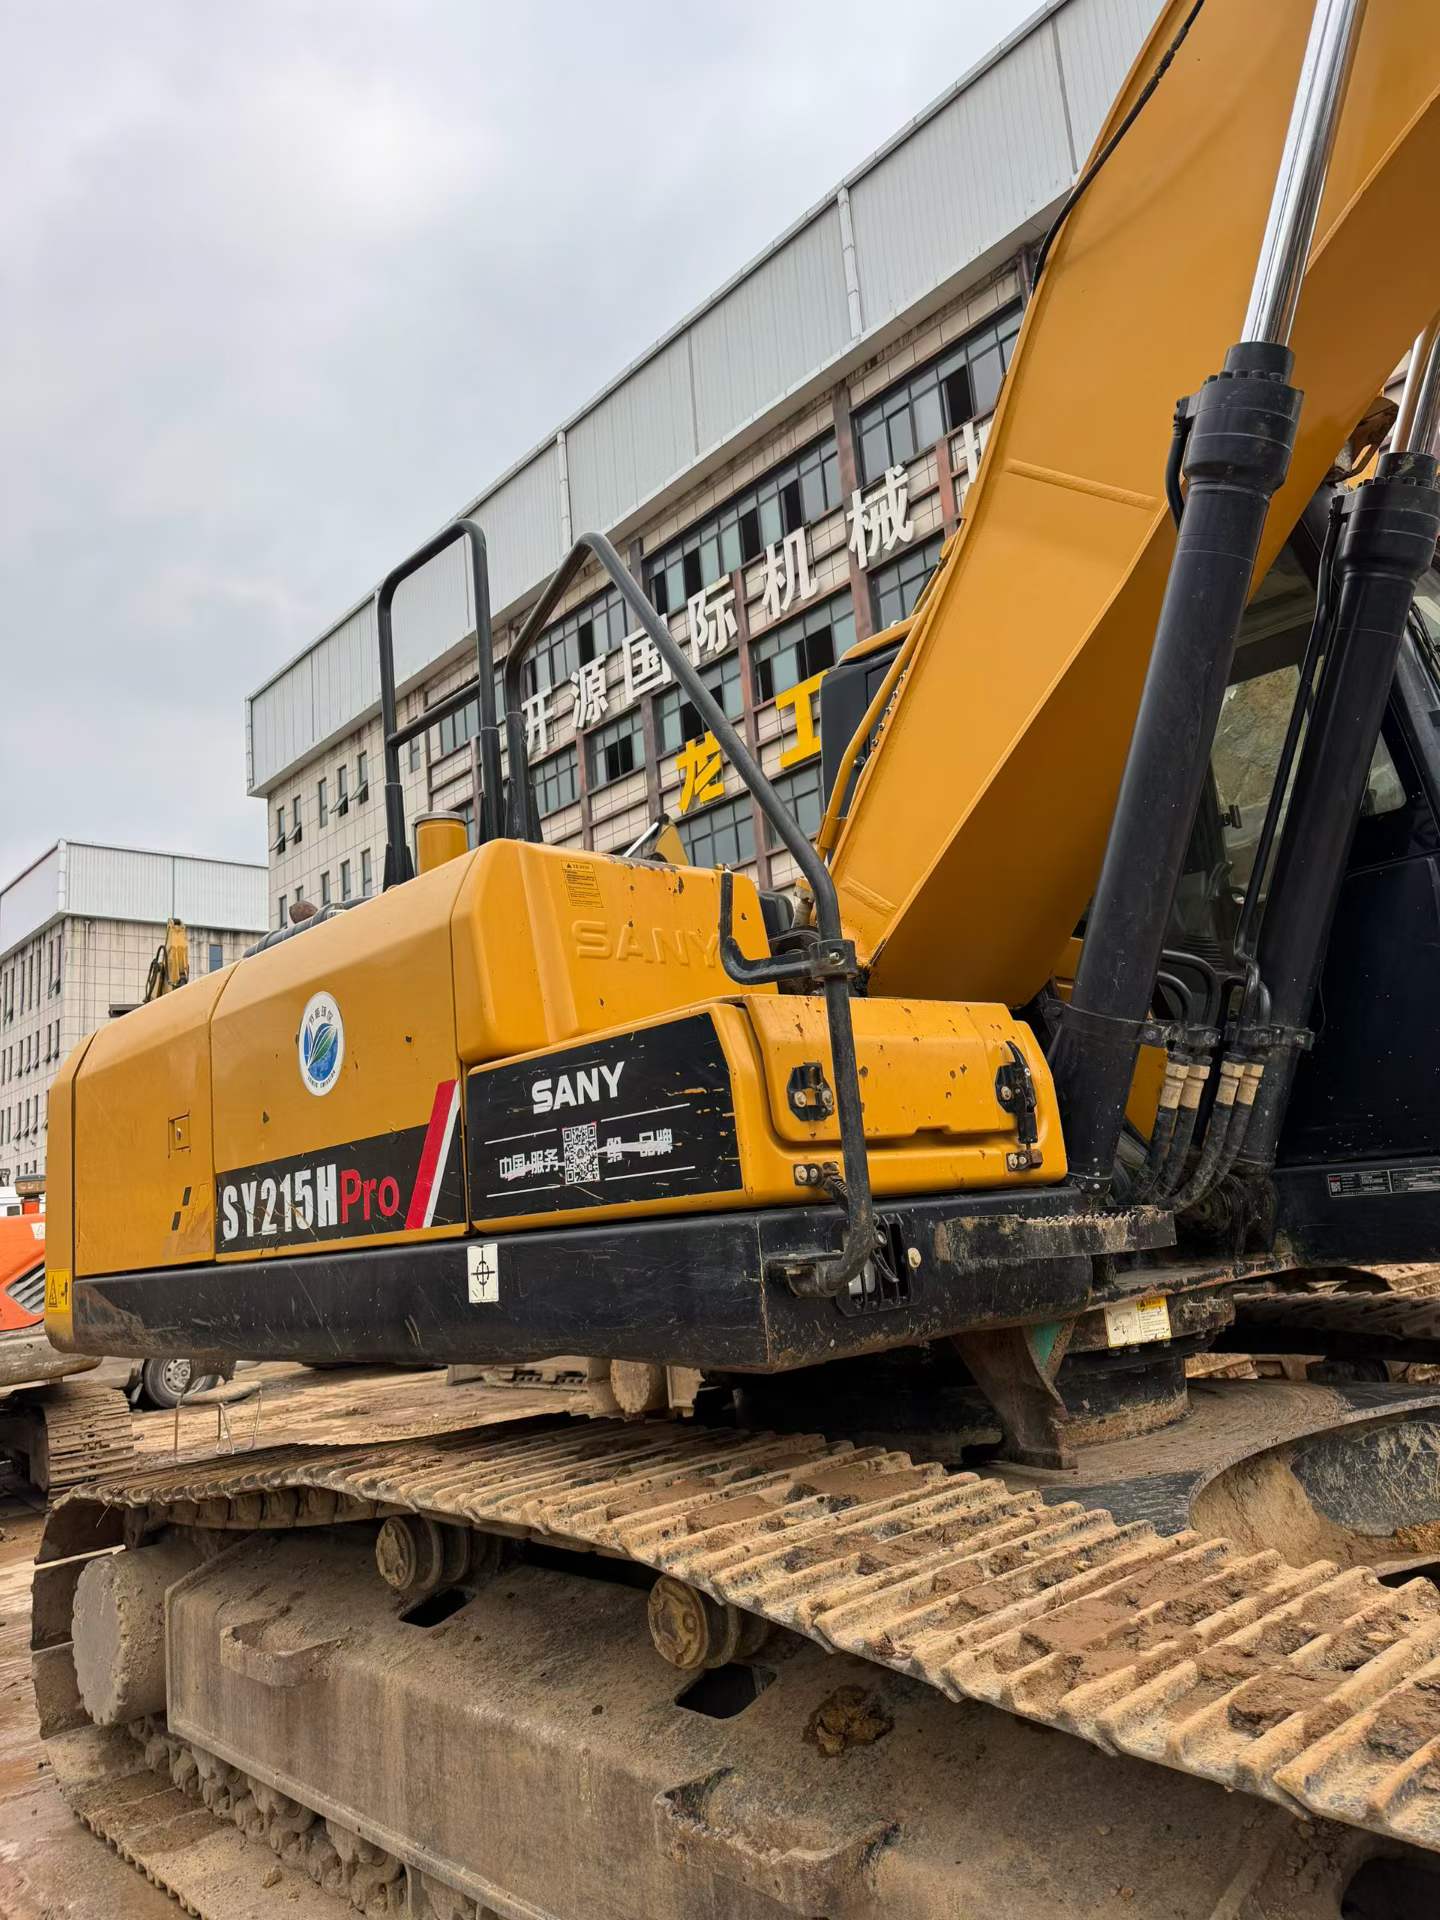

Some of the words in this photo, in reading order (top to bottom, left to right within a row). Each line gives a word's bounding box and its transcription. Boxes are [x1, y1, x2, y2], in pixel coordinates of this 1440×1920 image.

[521, 421, 992, 756] 开源国际机械
[676, 669, 828, 814] 龙工
[571, 919, 720, 969] SANY
[531, 1061, 625, 1115] SANY
[606, 1128, 674, 1164] 第品牌
